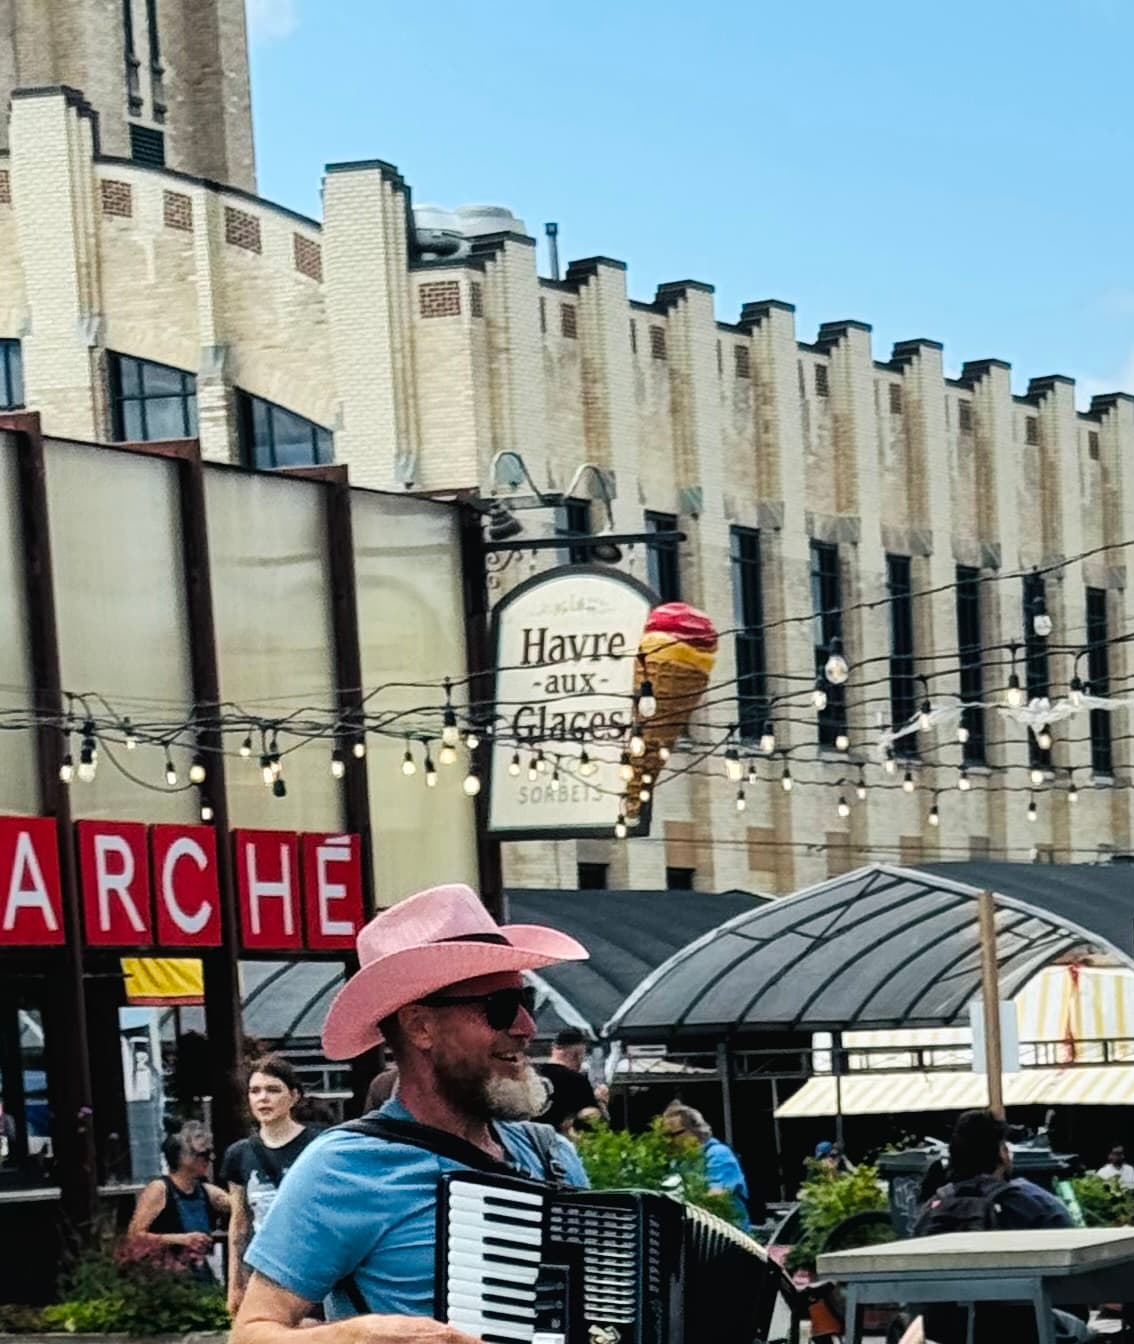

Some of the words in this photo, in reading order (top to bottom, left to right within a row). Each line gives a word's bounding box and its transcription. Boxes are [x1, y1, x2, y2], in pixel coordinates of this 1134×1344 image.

[519, 627, 626, 666] Havre
[512, 705, 627, 741] Glaces
[2, 831, 356, 936] ARCHÉ
